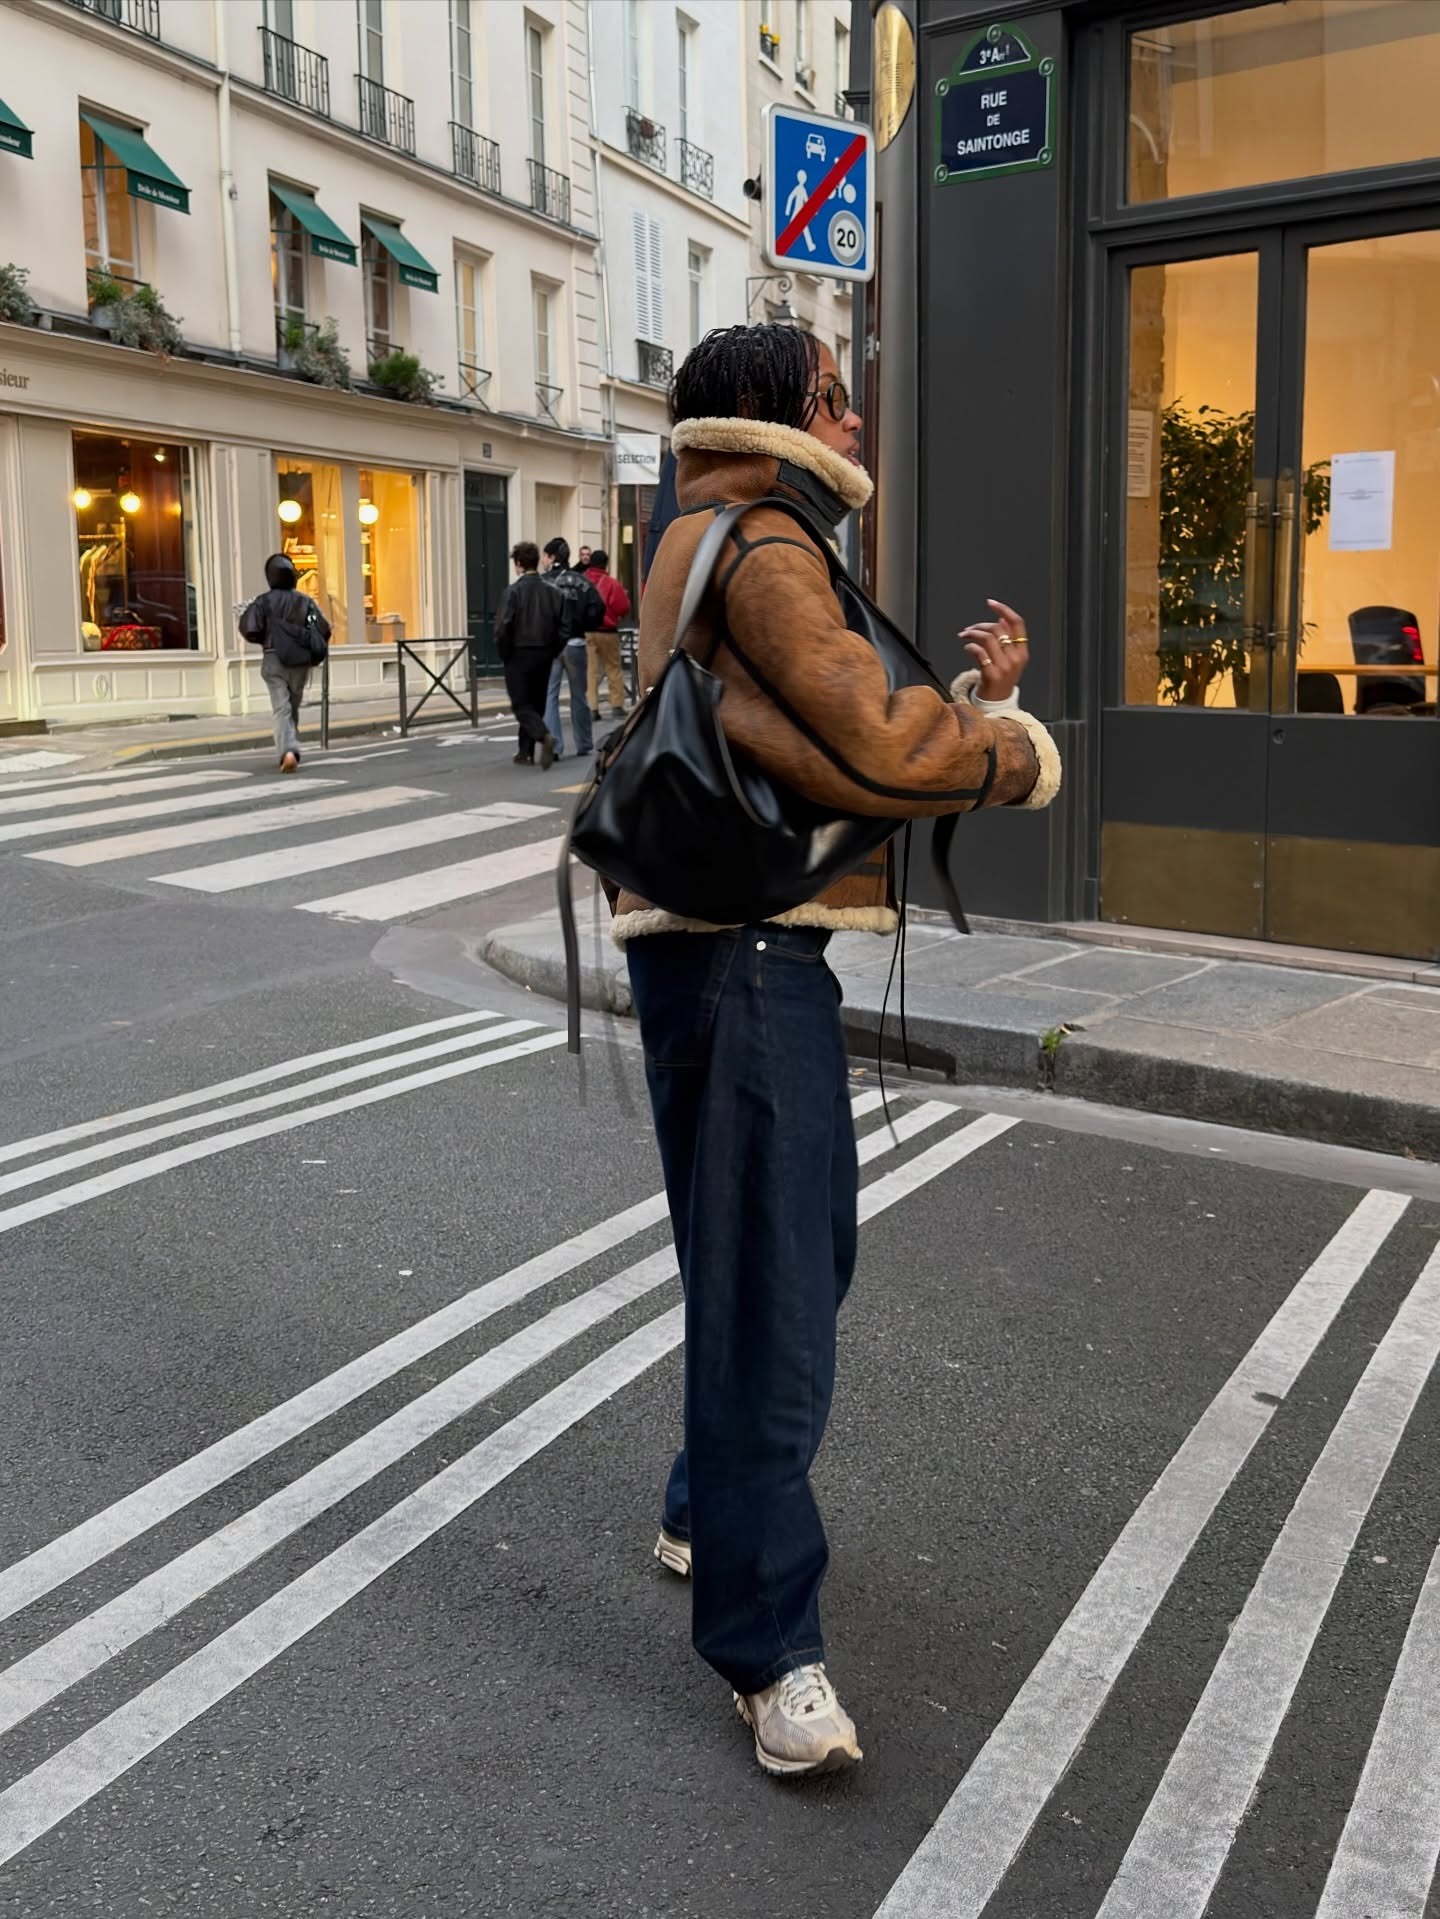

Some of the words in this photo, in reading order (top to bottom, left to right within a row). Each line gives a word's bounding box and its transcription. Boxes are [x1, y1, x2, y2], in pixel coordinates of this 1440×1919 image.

[980, 90, 1008, 110] RUE
[986, 113, 1001, 127] DE
[957, 129, 1030, 155] SAINTONGE
[837, 228, 856, 249] 20
